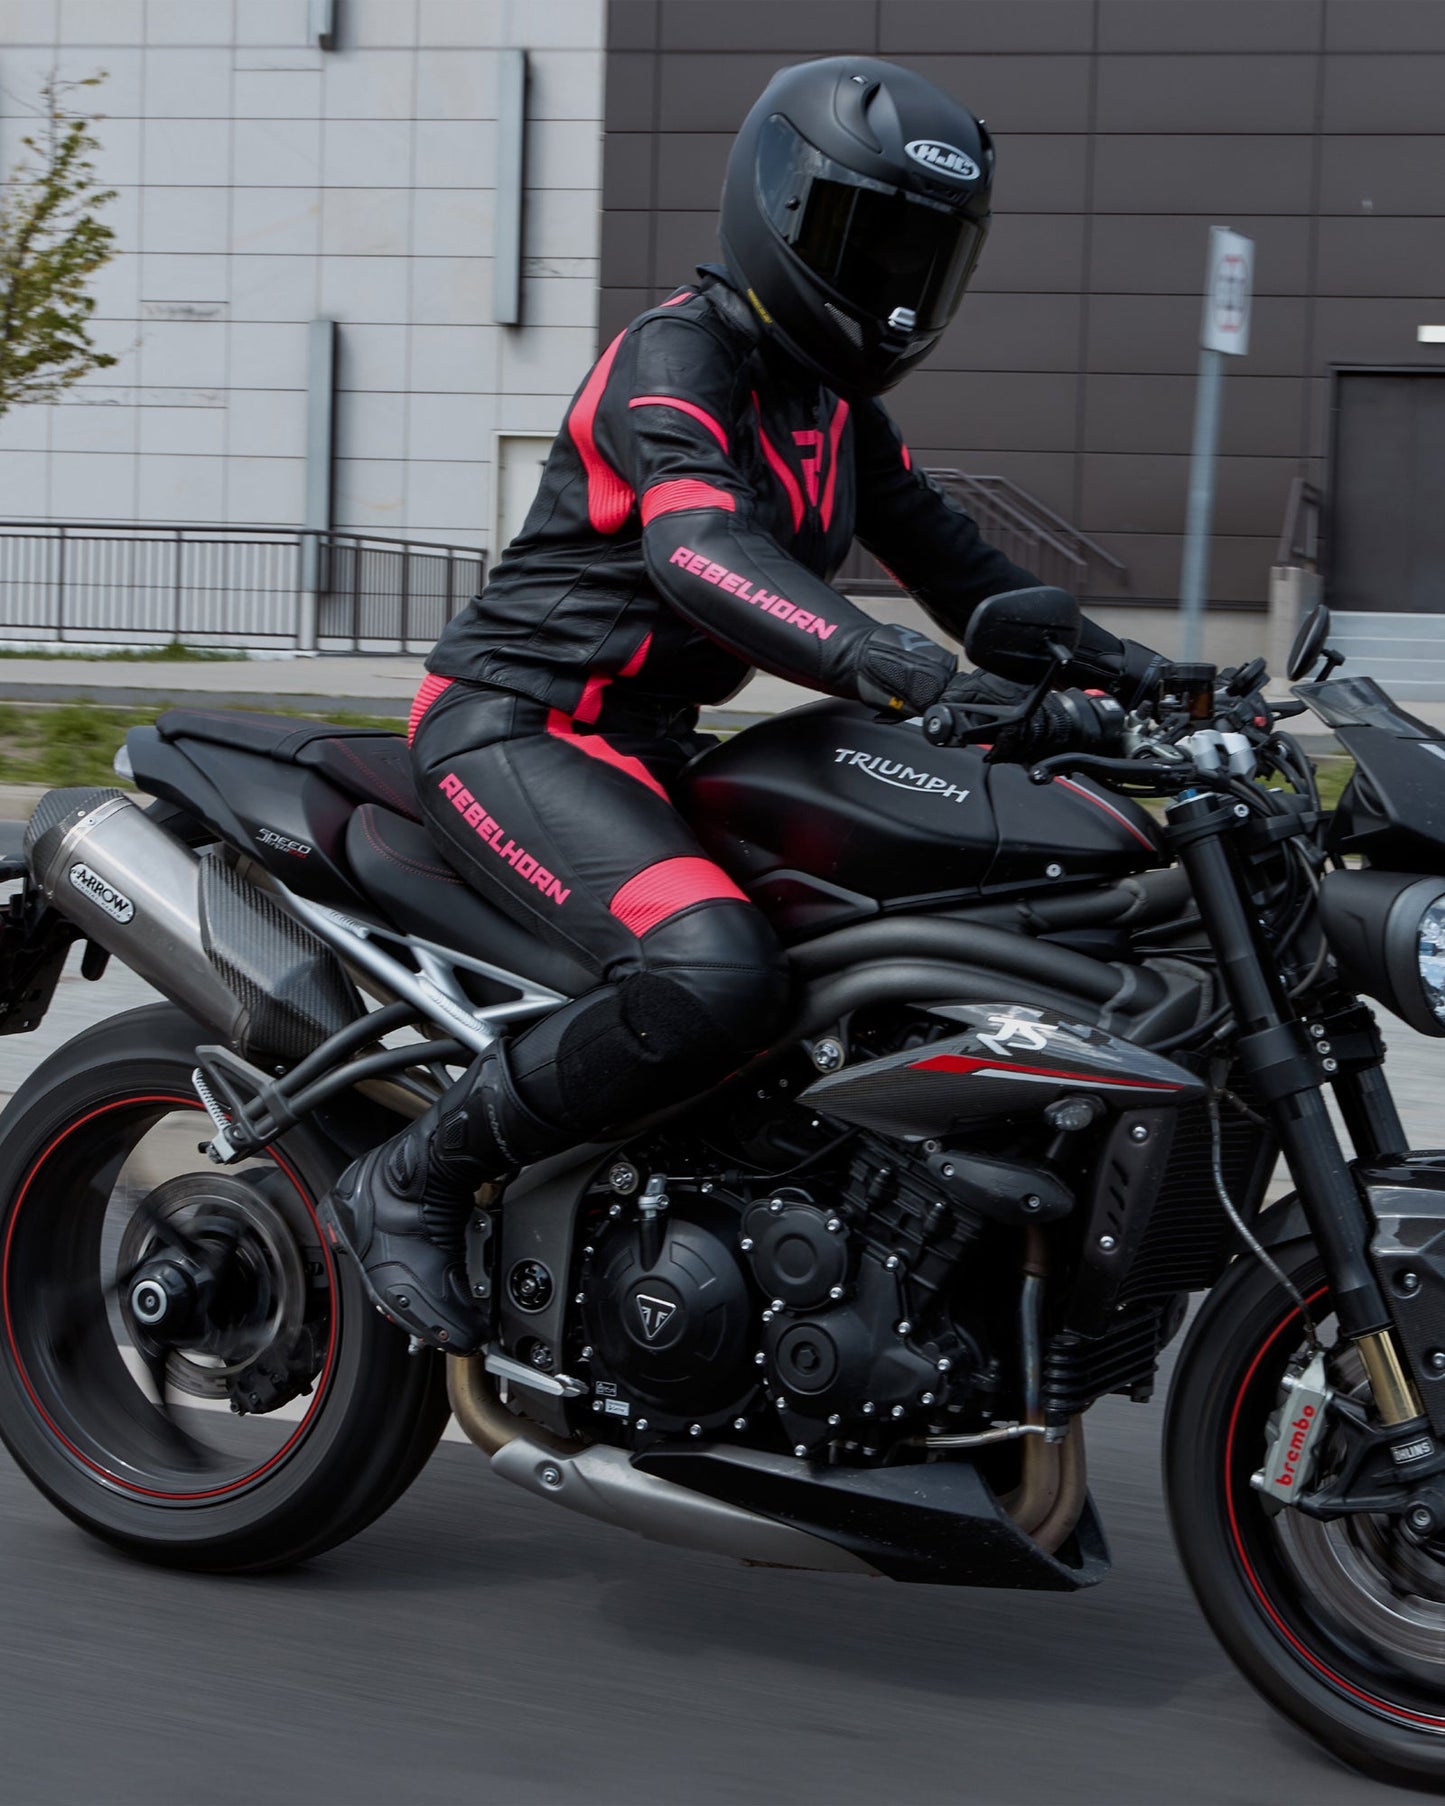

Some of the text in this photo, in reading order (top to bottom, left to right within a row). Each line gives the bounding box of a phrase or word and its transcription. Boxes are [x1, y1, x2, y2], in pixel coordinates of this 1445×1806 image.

[916, 144, 974, 175] HJC
[669, 546, 838, 640] REBELHORN
[834, 748, 970, 803] TRIUMPH
[438, 773, 572, 905] REBELHORN
[77, 869, 129, 912] ARROW
[976, 1016, 1059, 1056] RS
[1276, 1405, 1316, 1487] brembo
